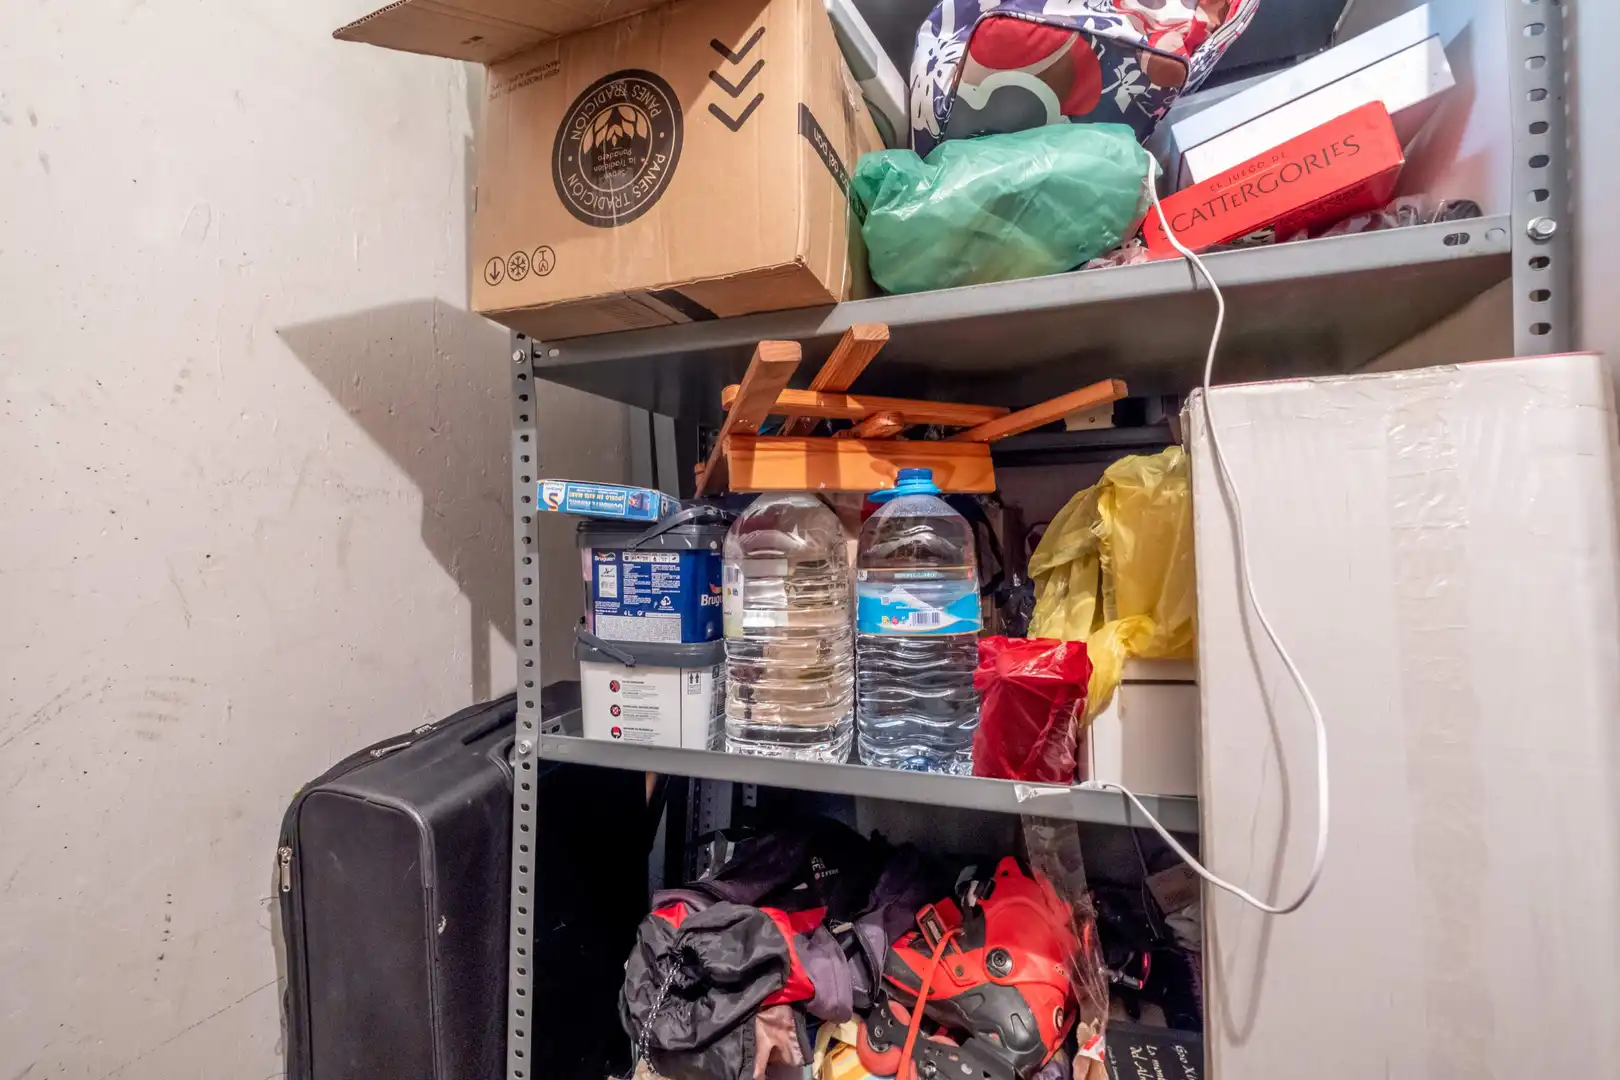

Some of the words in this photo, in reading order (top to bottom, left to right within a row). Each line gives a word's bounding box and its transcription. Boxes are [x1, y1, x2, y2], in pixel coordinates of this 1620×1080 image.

[631, 84, 662, 119] PANES
[631, 153, 665, 198] PANES
[1209, 182, 1223, 192] EL
[1228, 160, 1266, 184] JUEGO
[1272, 150, 1288, 164] DE
[566, 173, 631, 210] TRADICIÓN
[1146, 1044, 1158, 1056] La
[1171, 1045, 1189, 1064] Gao
